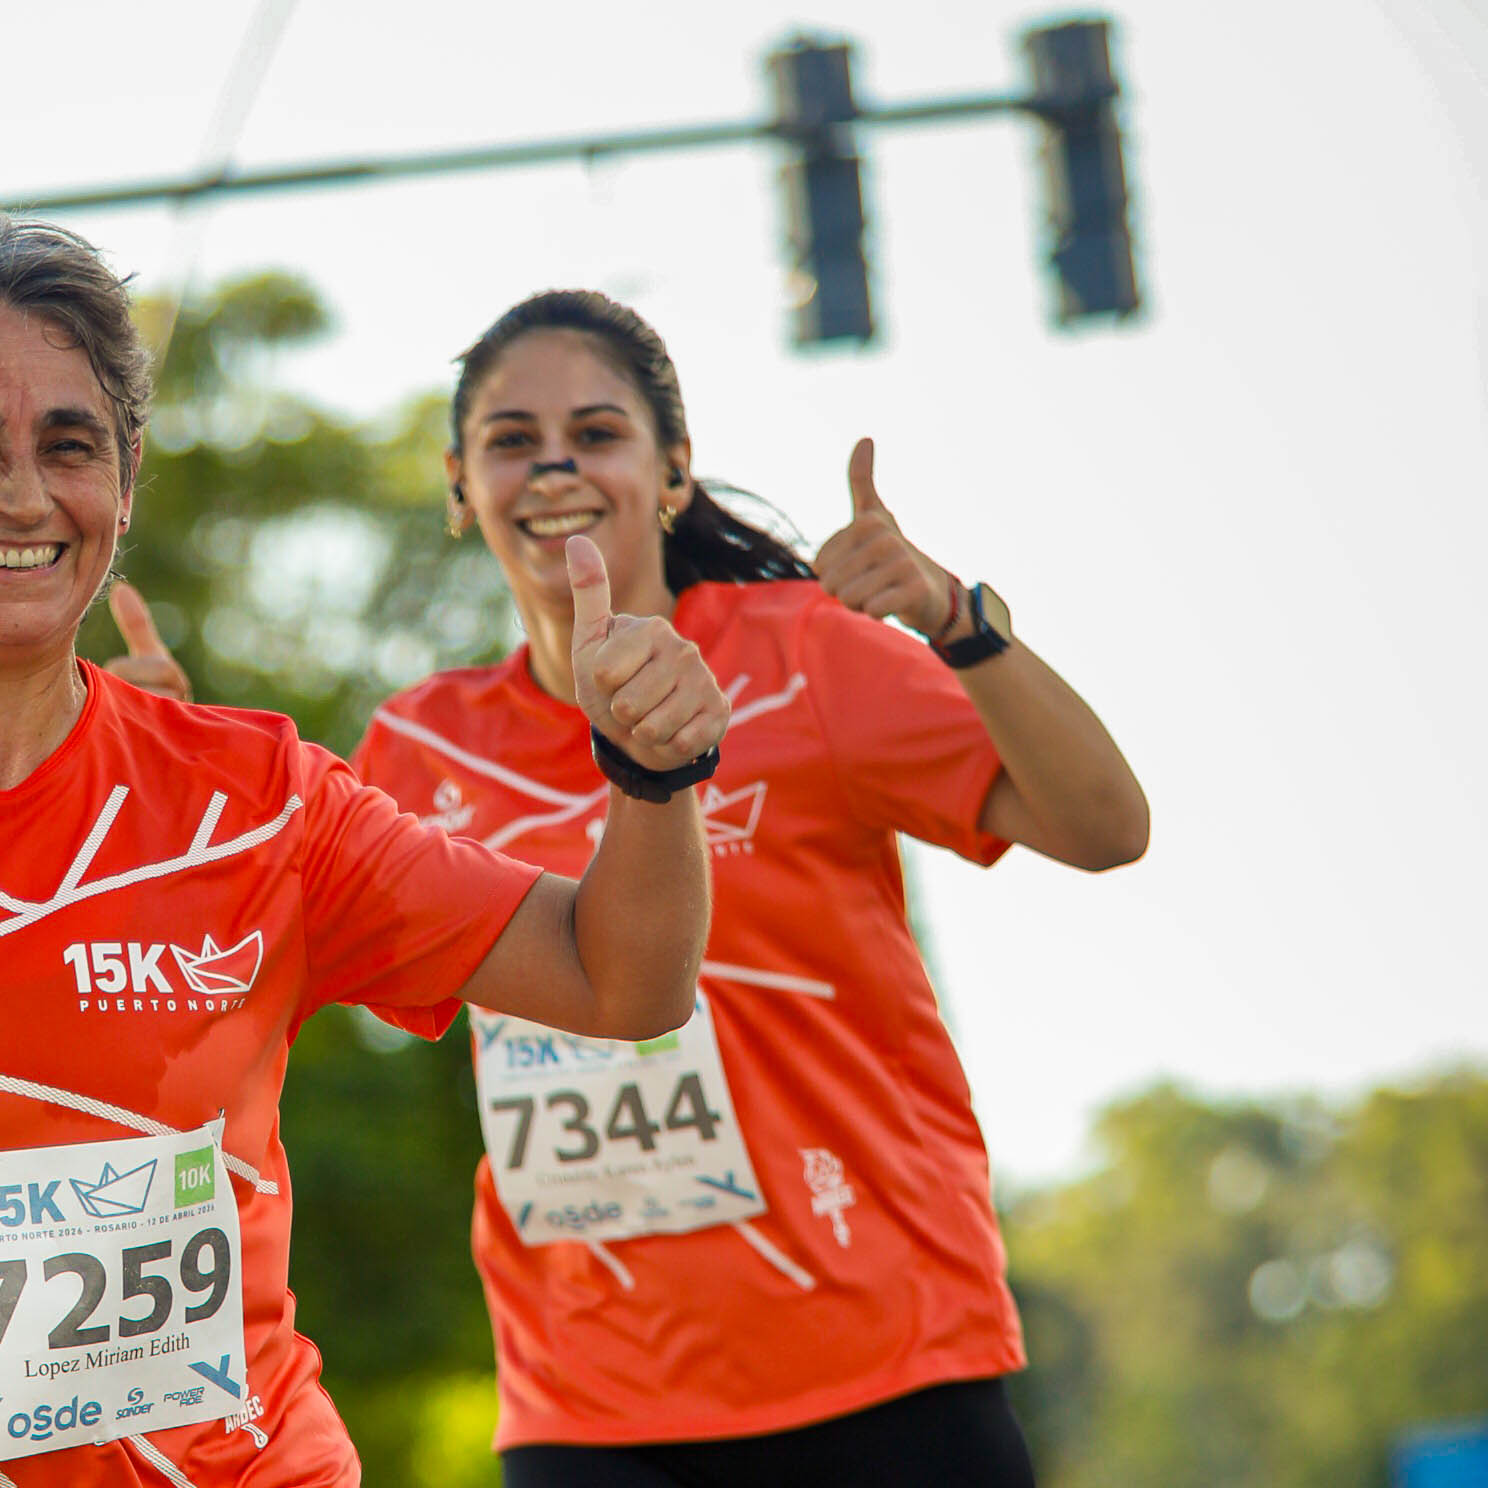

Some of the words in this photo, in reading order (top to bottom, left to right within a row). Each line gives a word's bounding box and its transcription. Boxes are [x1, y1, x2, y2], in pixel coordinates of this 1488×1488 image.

[63, 942, 174, 993] 15K
[79, 1000, 177, 1012] PUERTO
[491, 1070, 722, 1171] 7344
[178, 1163, 212, 1191] 10K
[21, 1229, 55, 1241] NORTE
[58, 1227, 83, 1238] 2026
[94, 1221, 137, 1233] ROSARIO
[147, 1217, 156, 1226] 12
[160, 1215, 169, 1224] DE
[173, 1210, 195, 1221] ABRIL
[24, 1357, 81, 1381] Lopez
[84, 1346, 144, 1370] Miriam
[150, 1333, 191, 1357] Edith
[7, 1395, 103, 1441] osde
[163, 1386, 205, 1402] POWER
